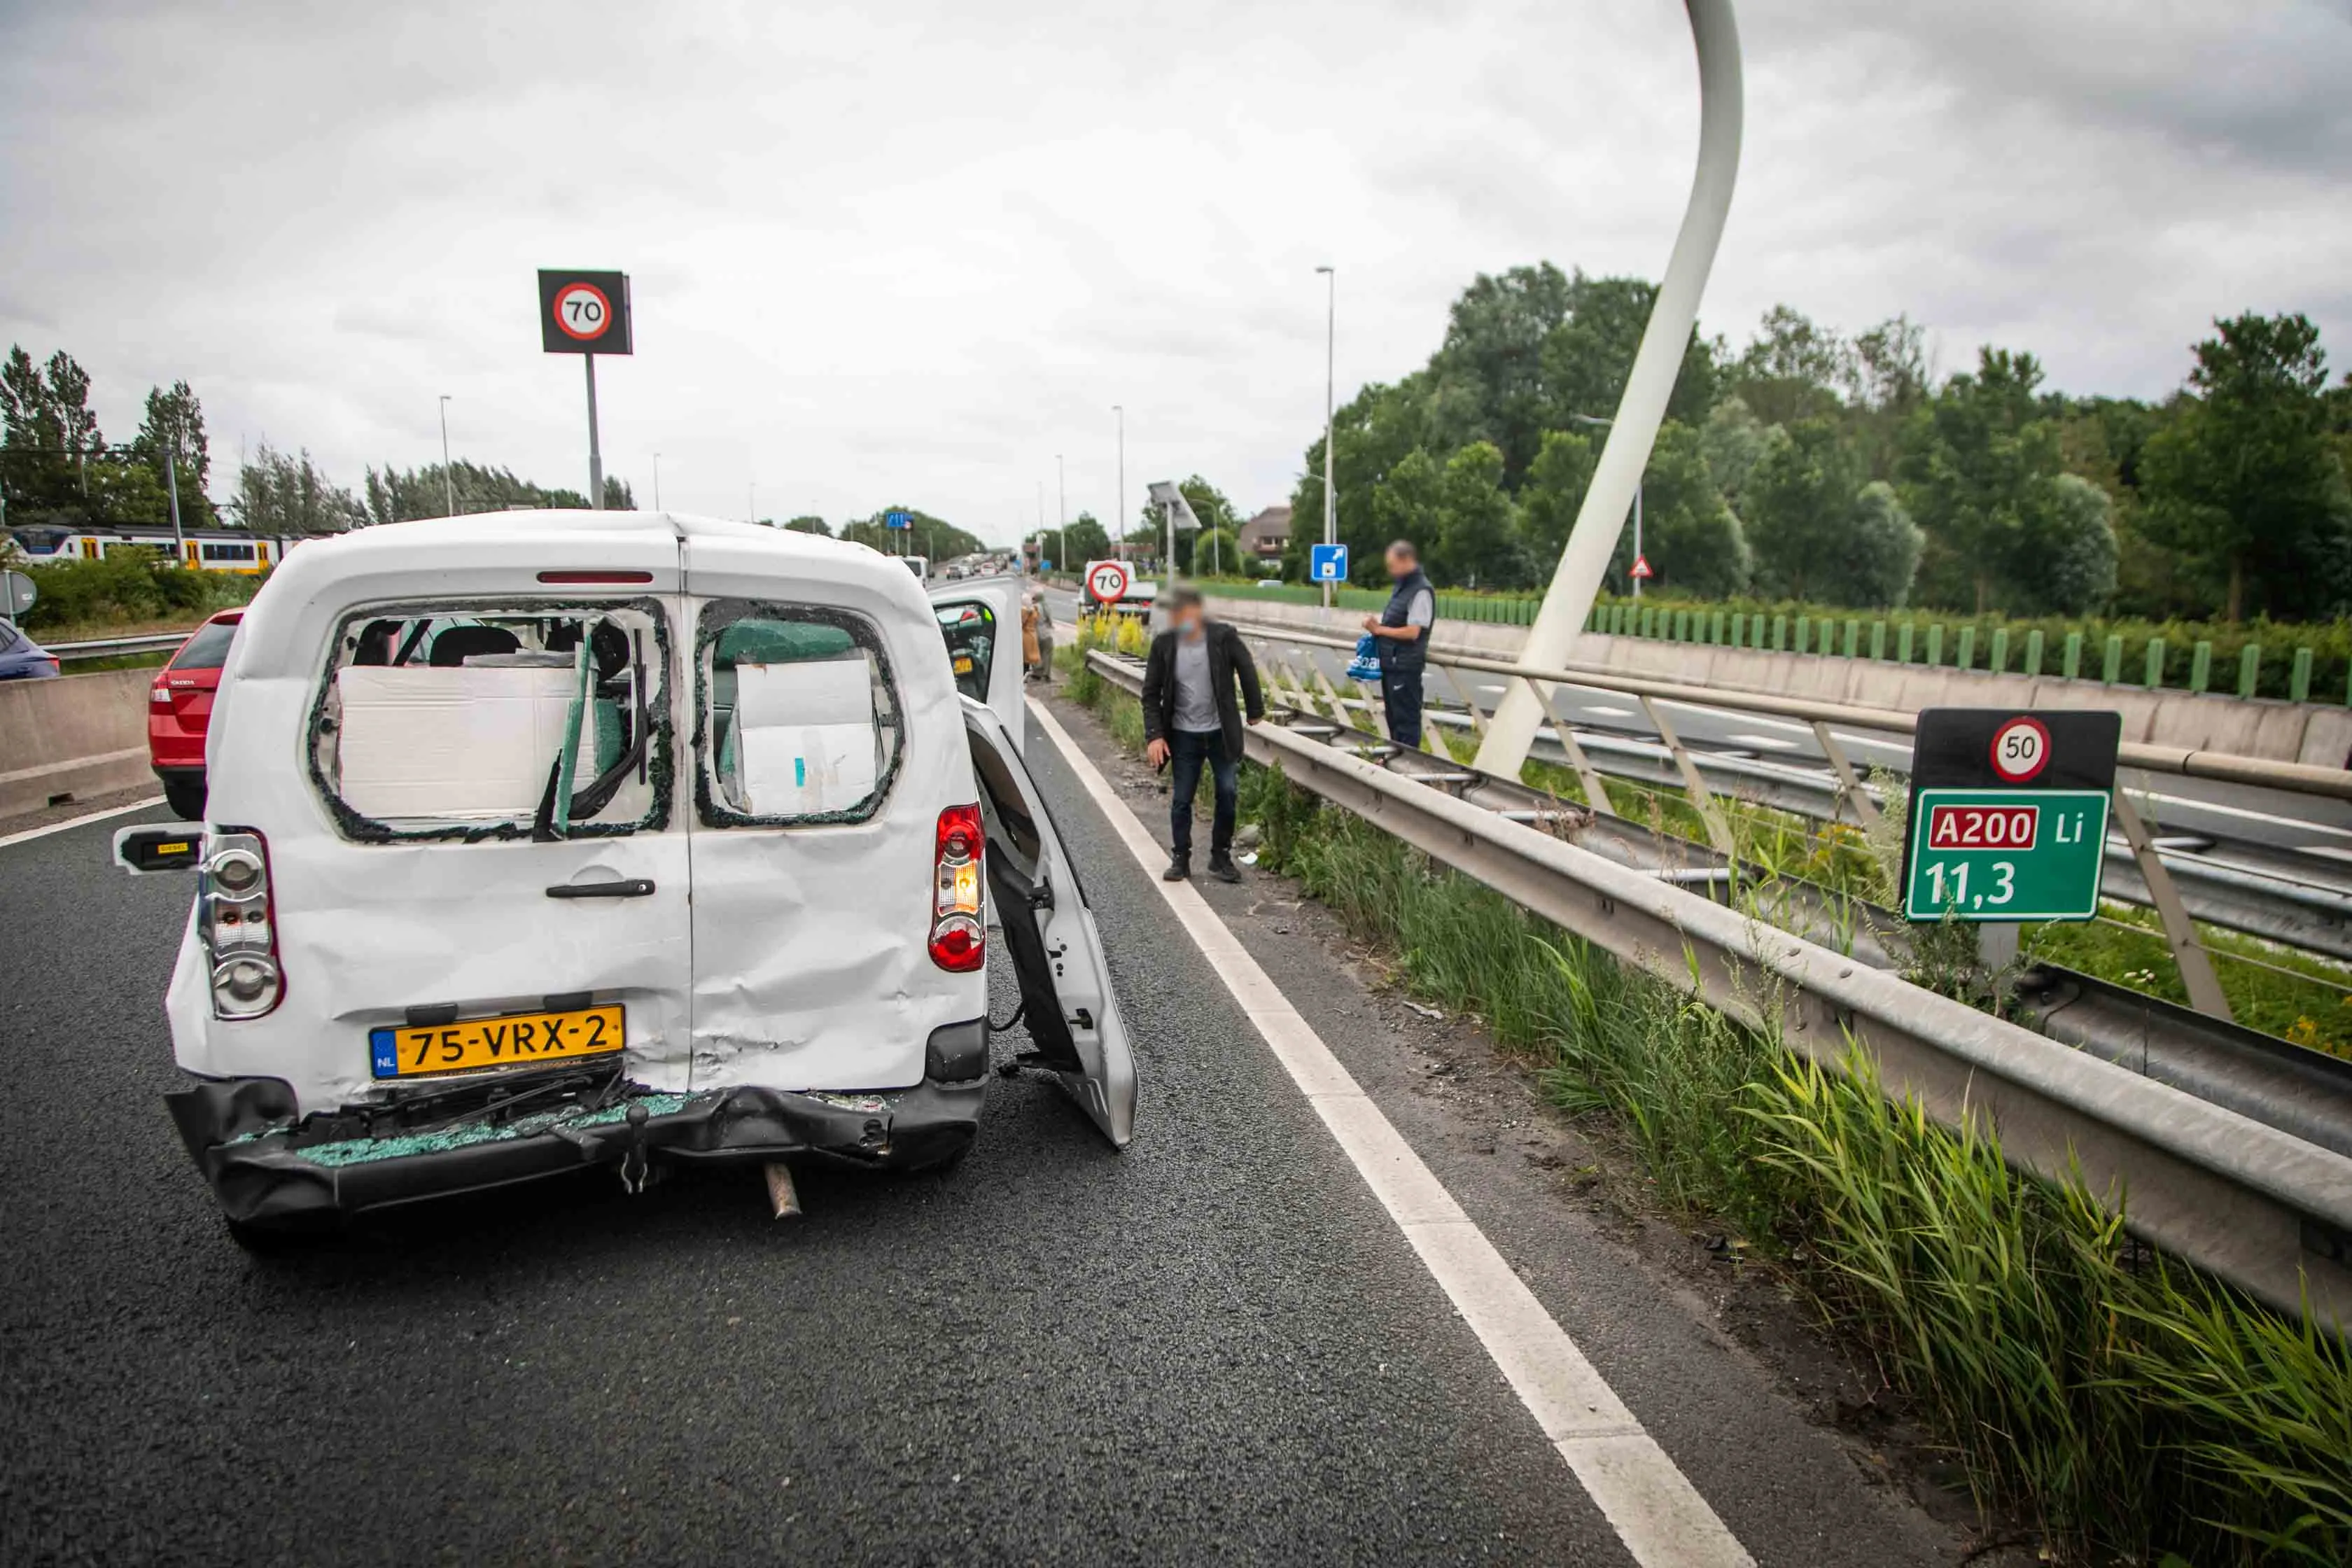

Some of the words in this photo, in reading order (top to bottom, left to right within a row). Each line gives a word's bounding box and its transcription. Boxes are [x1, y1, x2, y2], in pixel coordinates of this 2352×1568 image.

[565, 300, 601, 321] 70
[1095, 574, 1121, 589] 70
[2005, 736, 2036, 759] 50
[1935, 812, 2031, 844] A200
[2055, 812, 2084, 842] Li
[1926, 862, 2015, 910] 11,3
[410, 1014, 608, 1065] 75-VRX-2
[377, 1057, 395, 1068] NL
